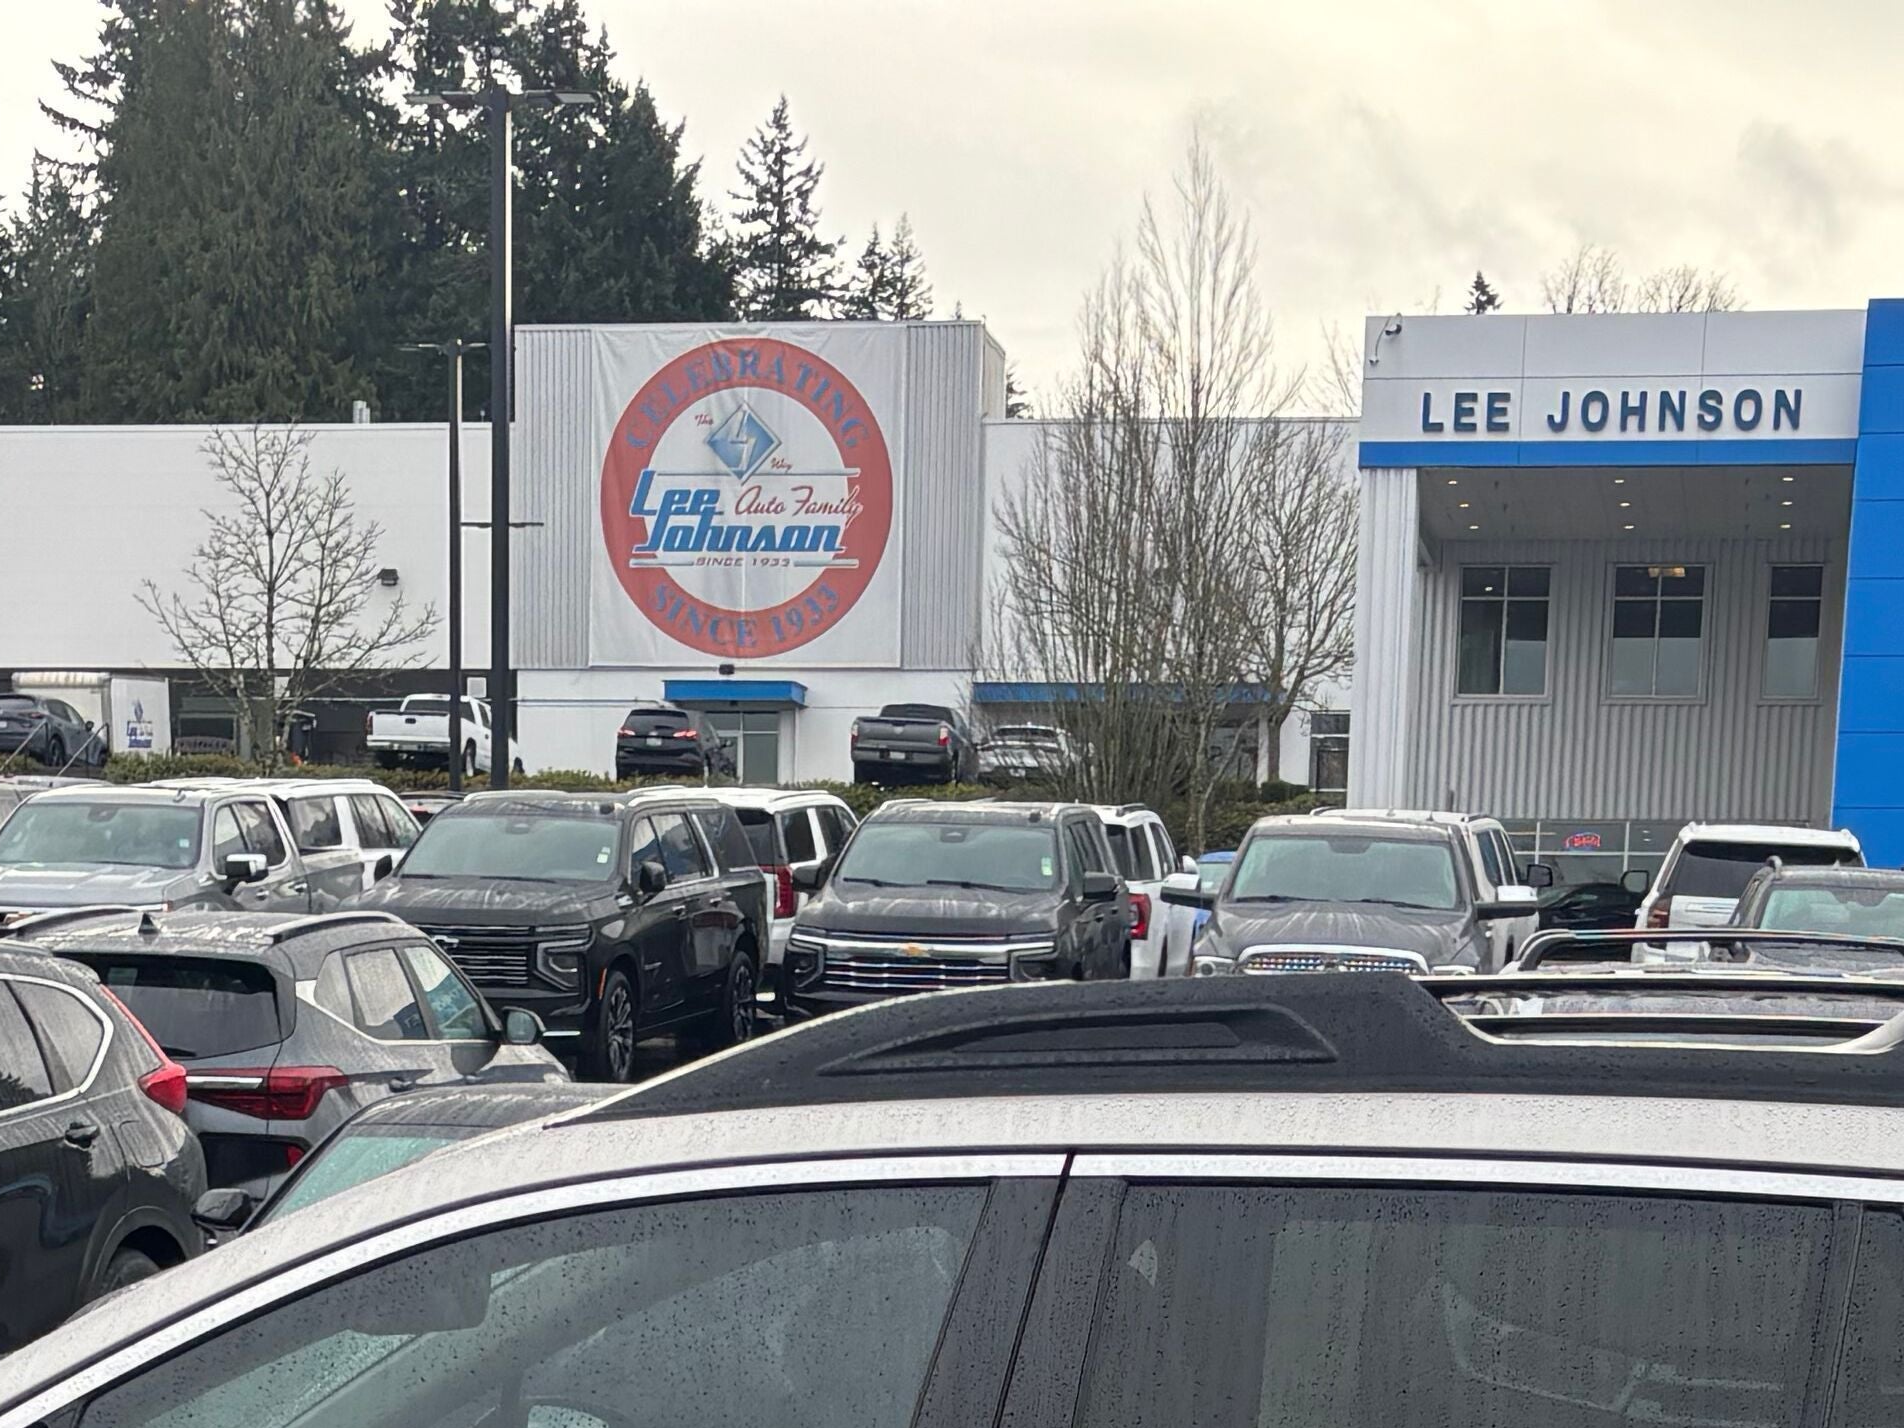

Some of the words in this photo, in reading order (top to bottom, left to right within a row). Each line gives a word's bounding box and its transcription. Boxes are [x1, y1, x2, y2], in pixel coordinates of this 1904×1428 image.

[626, 347, 870, 448] CELEBRATING
[1422, 391, 1511, 433] LEE
[1547, 389, 1803, 433] JOHNSON
[631, 469, 725, 516] Lee
[735, 485, 787, 516] Auto
[790, 485, 864, 528] Family
[633, 508, 848, 553] Johnson
[696, 557, 744, 568] SINCE
[752, 557, 791, 568] 1933
[654, 583, 758, 648] SINCE
[769, 582, 840, 643] 1933
